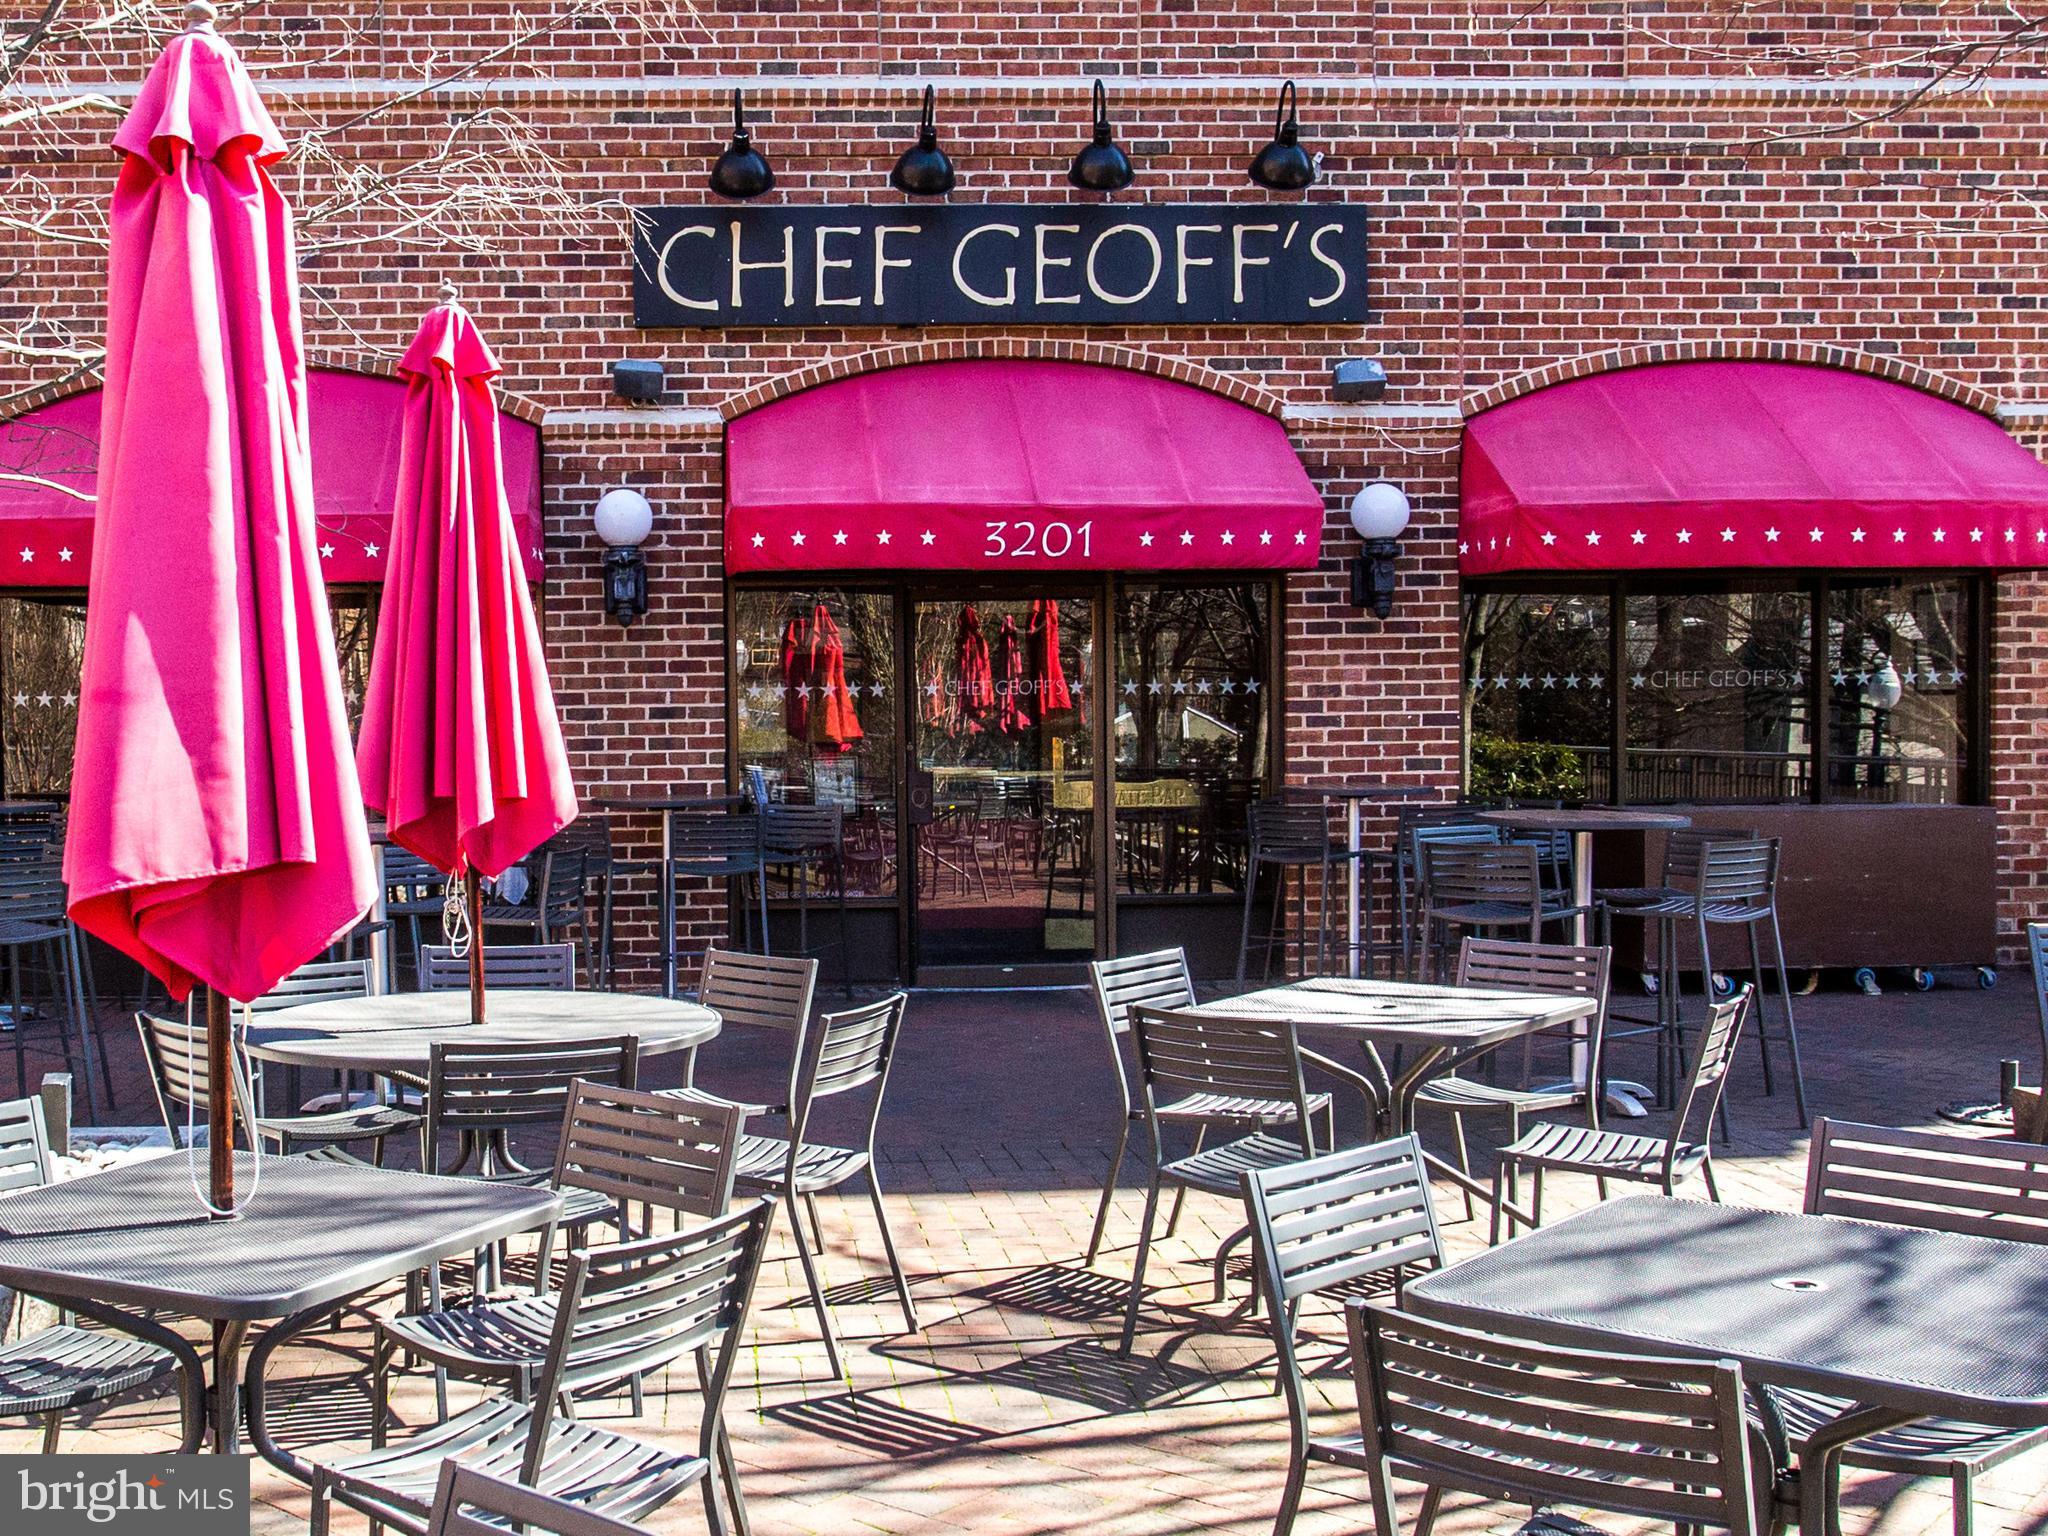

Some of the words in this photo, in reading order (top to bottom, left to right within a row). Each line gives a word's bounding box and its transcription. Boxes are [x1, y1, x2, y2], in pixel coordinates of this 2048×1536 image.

[657, 220, 922, 311] CHEF
[952, 219, 1347, 307] GEOFF'S
[984, 521, 1093, 557] 3201
[944, 679, 992, 697] CHEF
[995, 678, 1064, 696] GEOFF'S
[1651, 670, 1704, 688] CHEF
[1708, 669, 1787, 687] GEOFF'S
